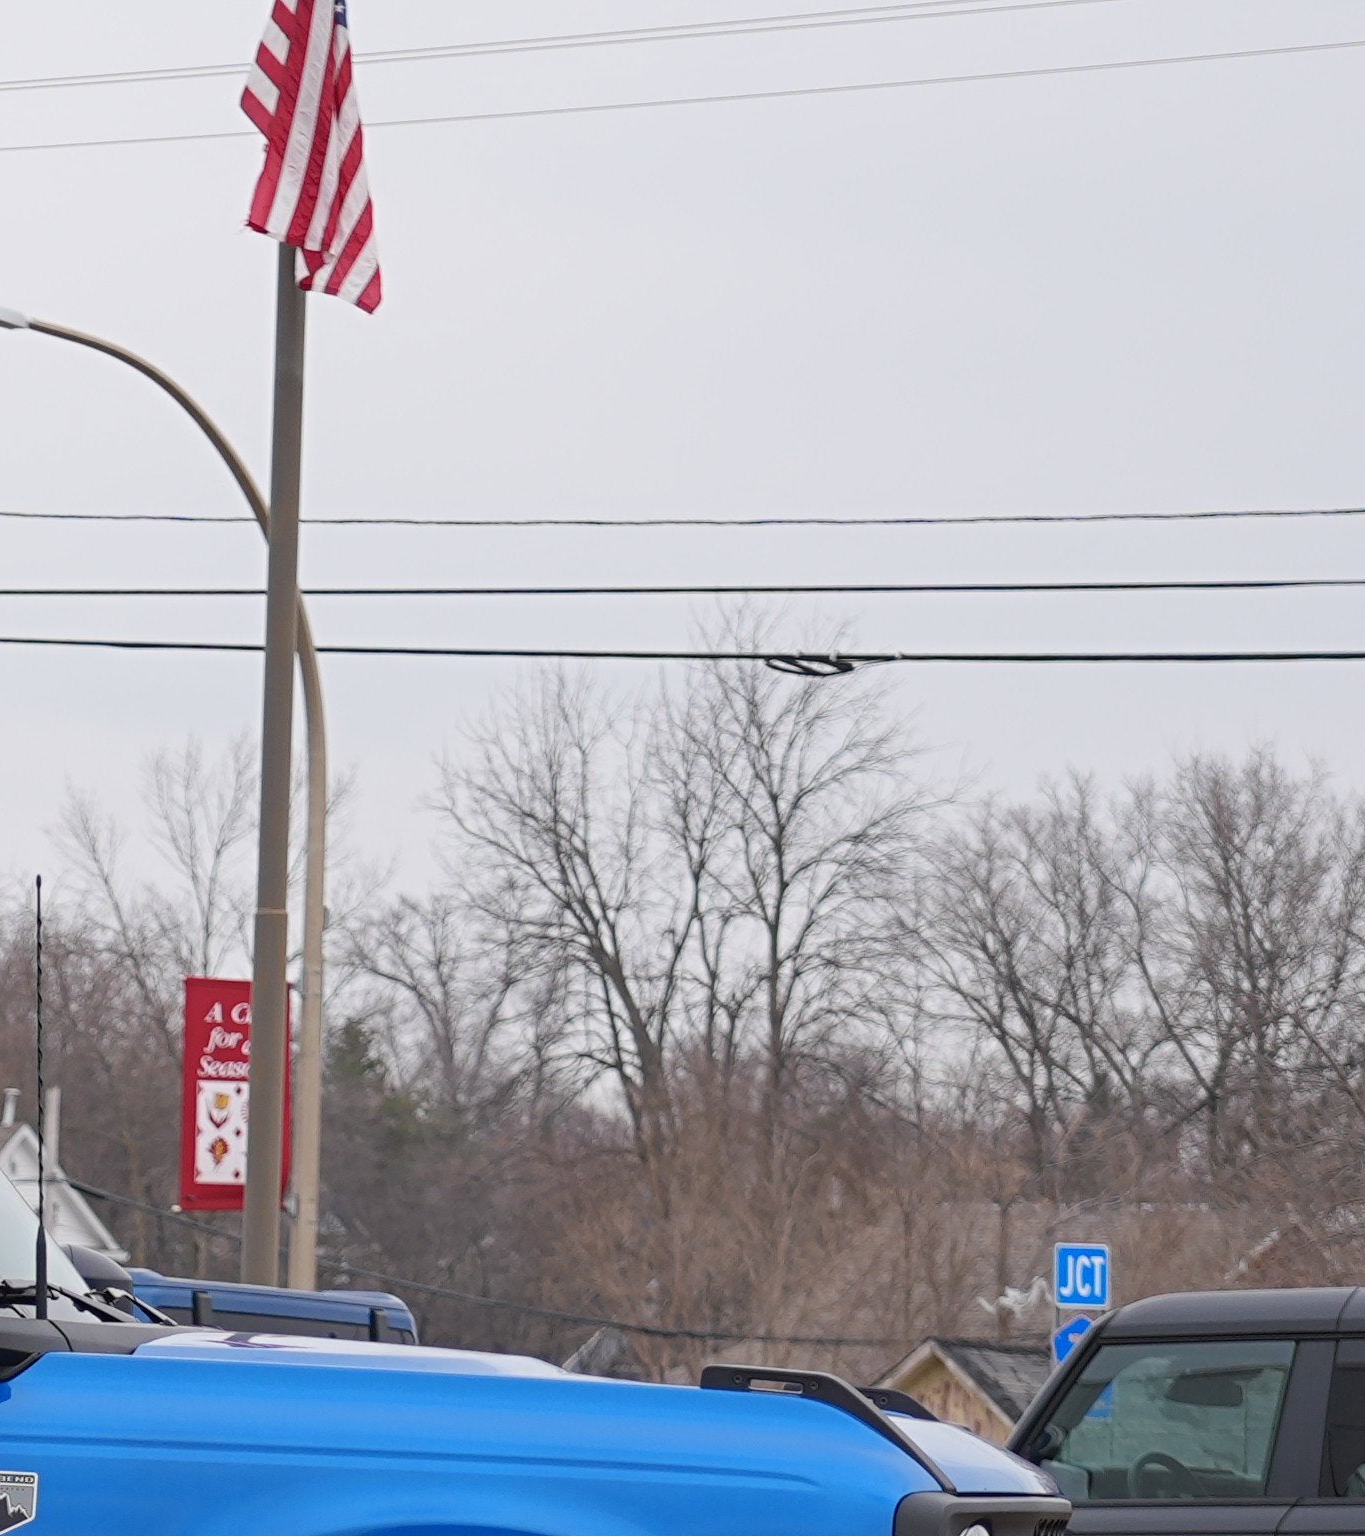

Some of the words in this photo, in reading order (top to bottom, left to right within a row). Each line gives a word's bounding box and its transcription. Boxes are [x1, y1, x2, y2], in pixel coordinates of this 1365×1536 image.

[203, 1001, 224, 1024] A
[202, 1026, 243, 1054] for
[1059, 1254, 1106, 1298] JCT
